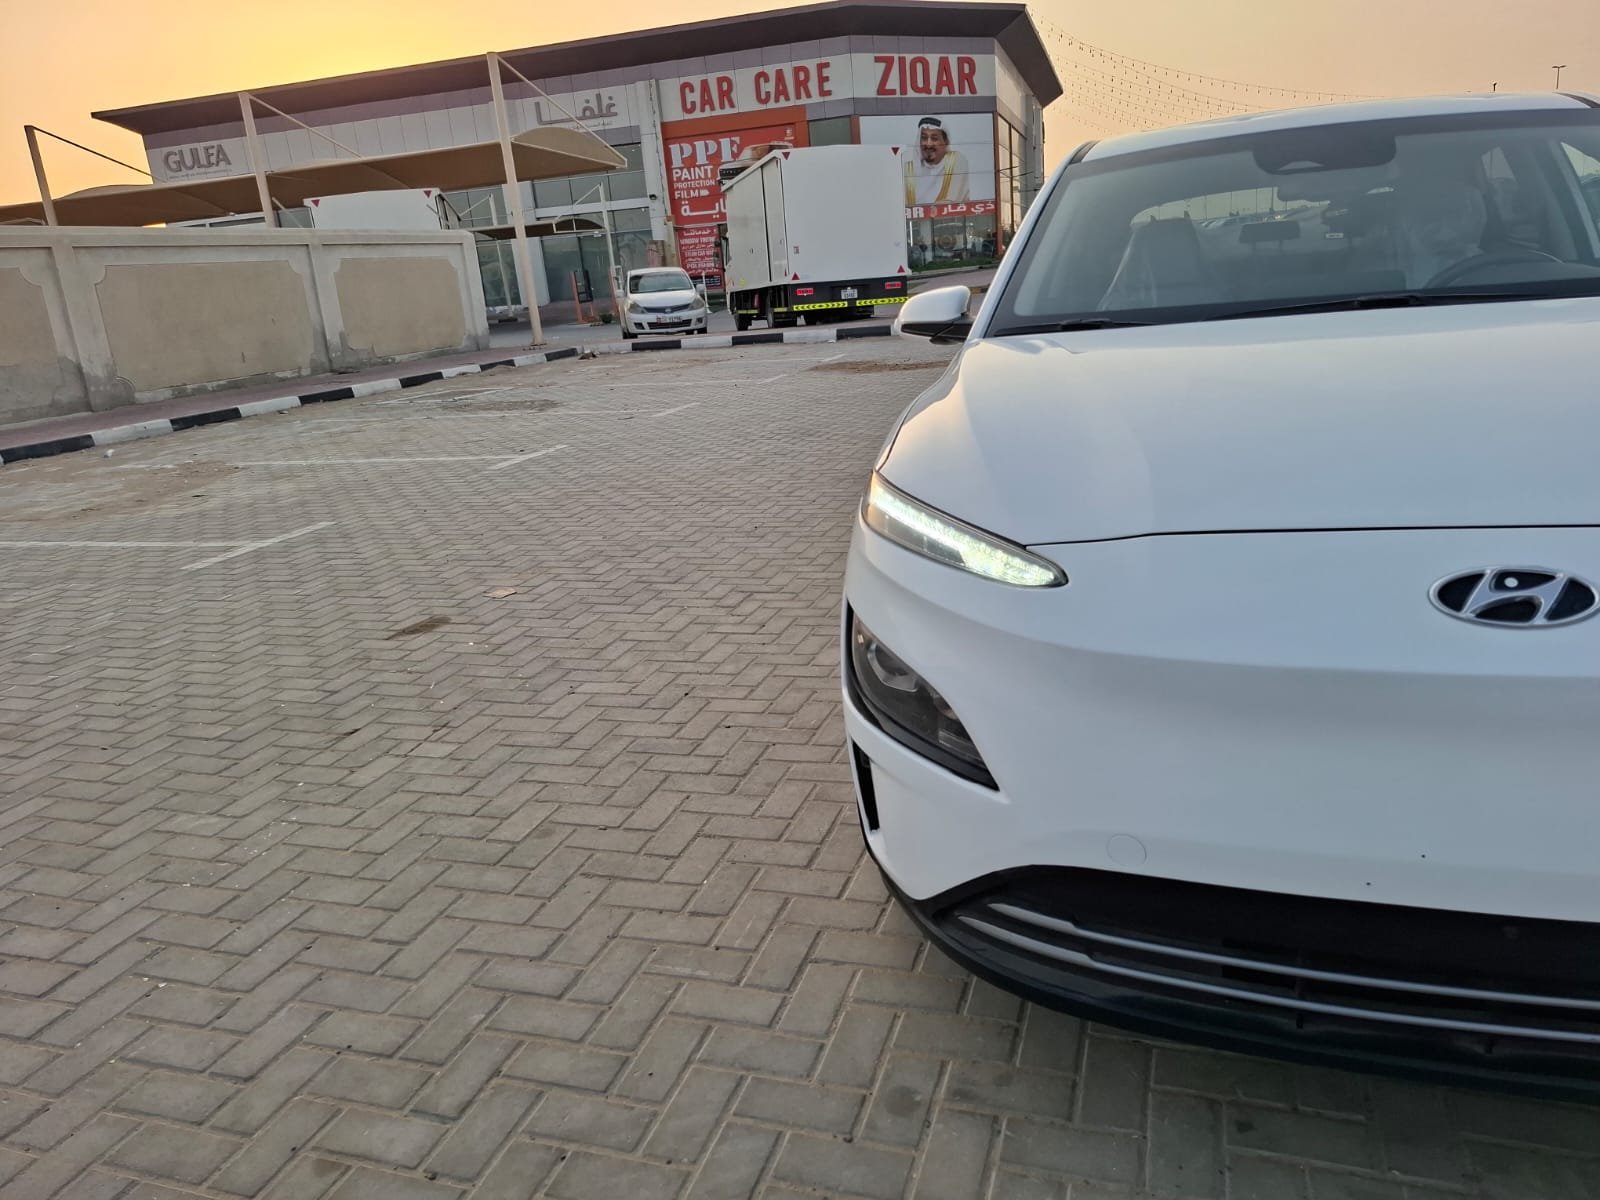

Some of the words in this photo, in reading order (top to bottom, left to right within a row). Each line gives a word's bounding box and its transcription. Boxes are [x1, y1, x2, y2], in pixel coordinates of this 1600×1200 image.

[680, 76, 735, 114] CAR
[754, 62, 832, 104] CARE
[874, 56, 977, 95] ZIQAR
[164, 144, 232, 172] GULFA
[669, 137, 740, 168] PPF
[673, 166, 713, 181] PAINT
[673, 180, 715, 189] PROTECTION
[675, 189, 698, 199] FILM
